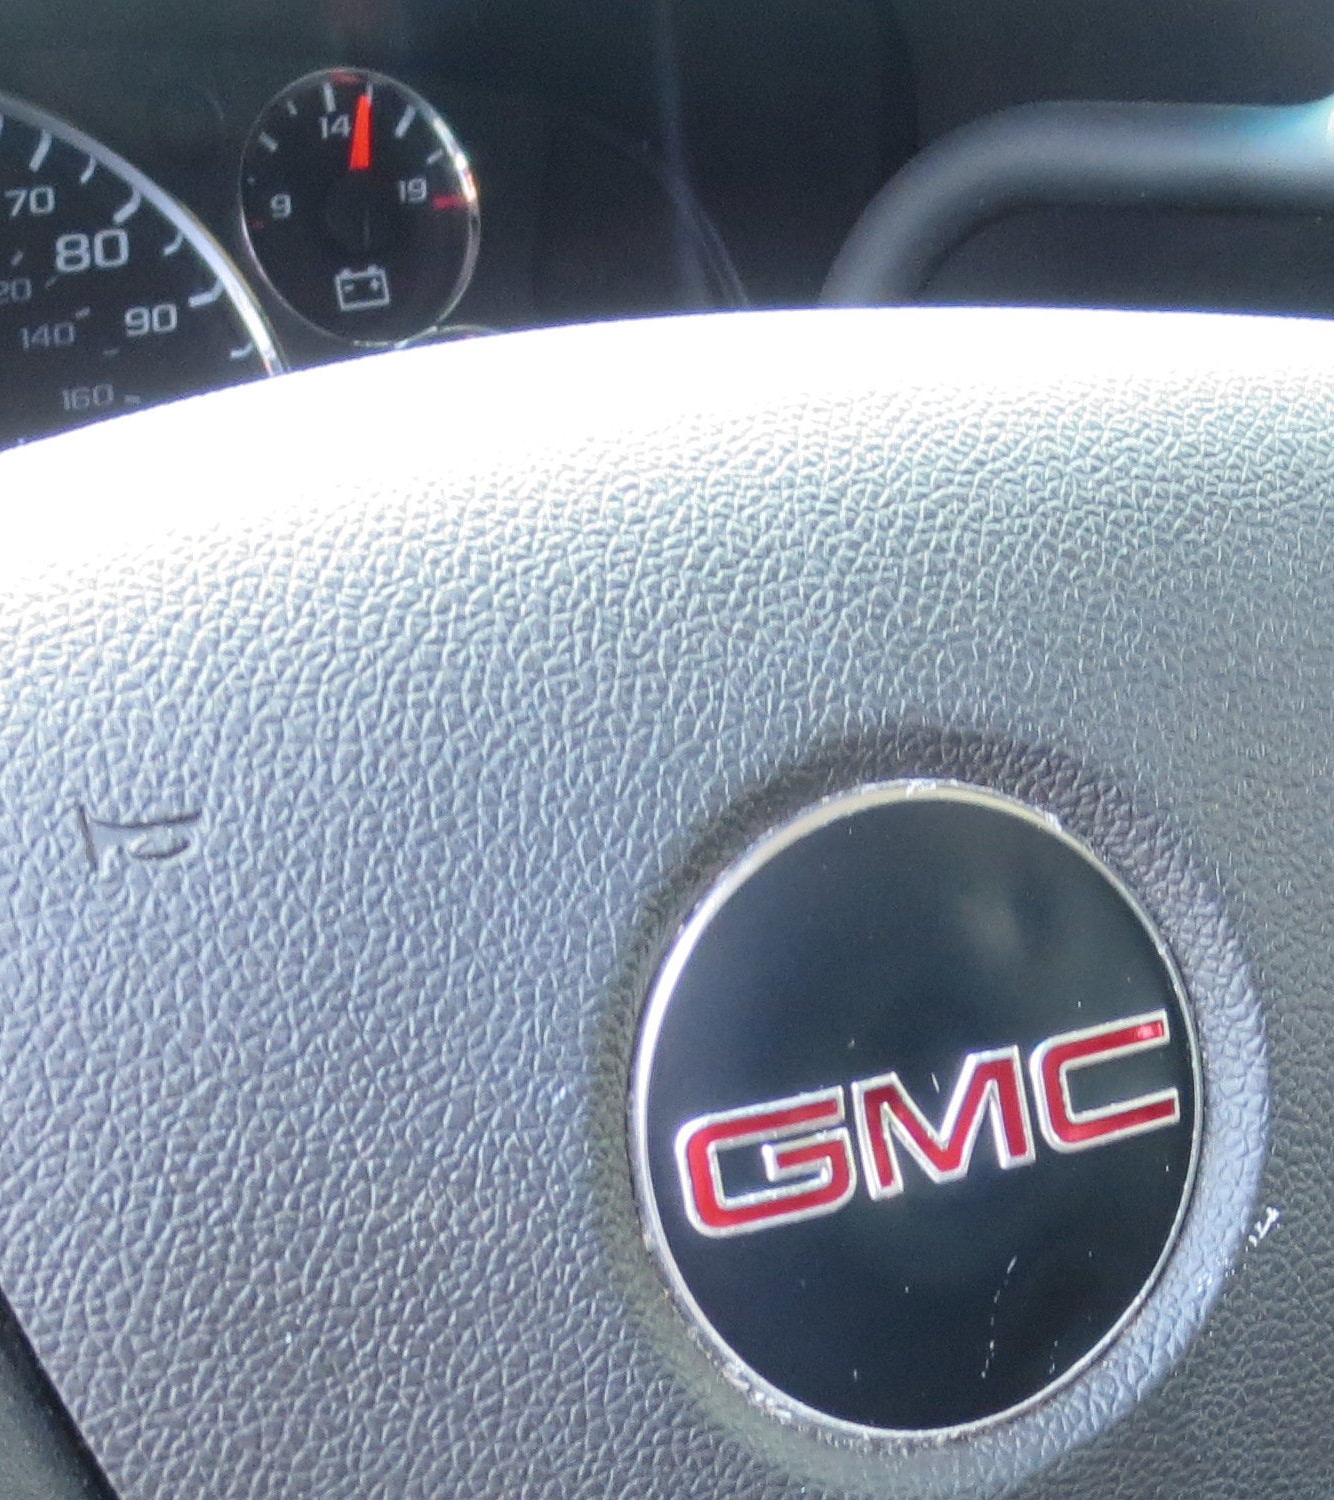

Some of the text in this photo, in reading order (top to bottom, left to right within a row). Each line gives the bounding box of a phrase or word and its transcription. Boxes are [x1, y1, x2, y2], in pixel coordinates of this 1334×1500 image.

[319, 114, 351, 140] 14
[4, 185, 55, 218] 70
[398, 176, 427, 203] 19
[270, 193, 292, 219] 9
[55, 228, 129, 273] 80
[124, 303, 178, 338] 90
[20, 322, 76, 350] 140
[61, 383, 115, 411] 160
[674, 1009, 1180, 1238] GMC
